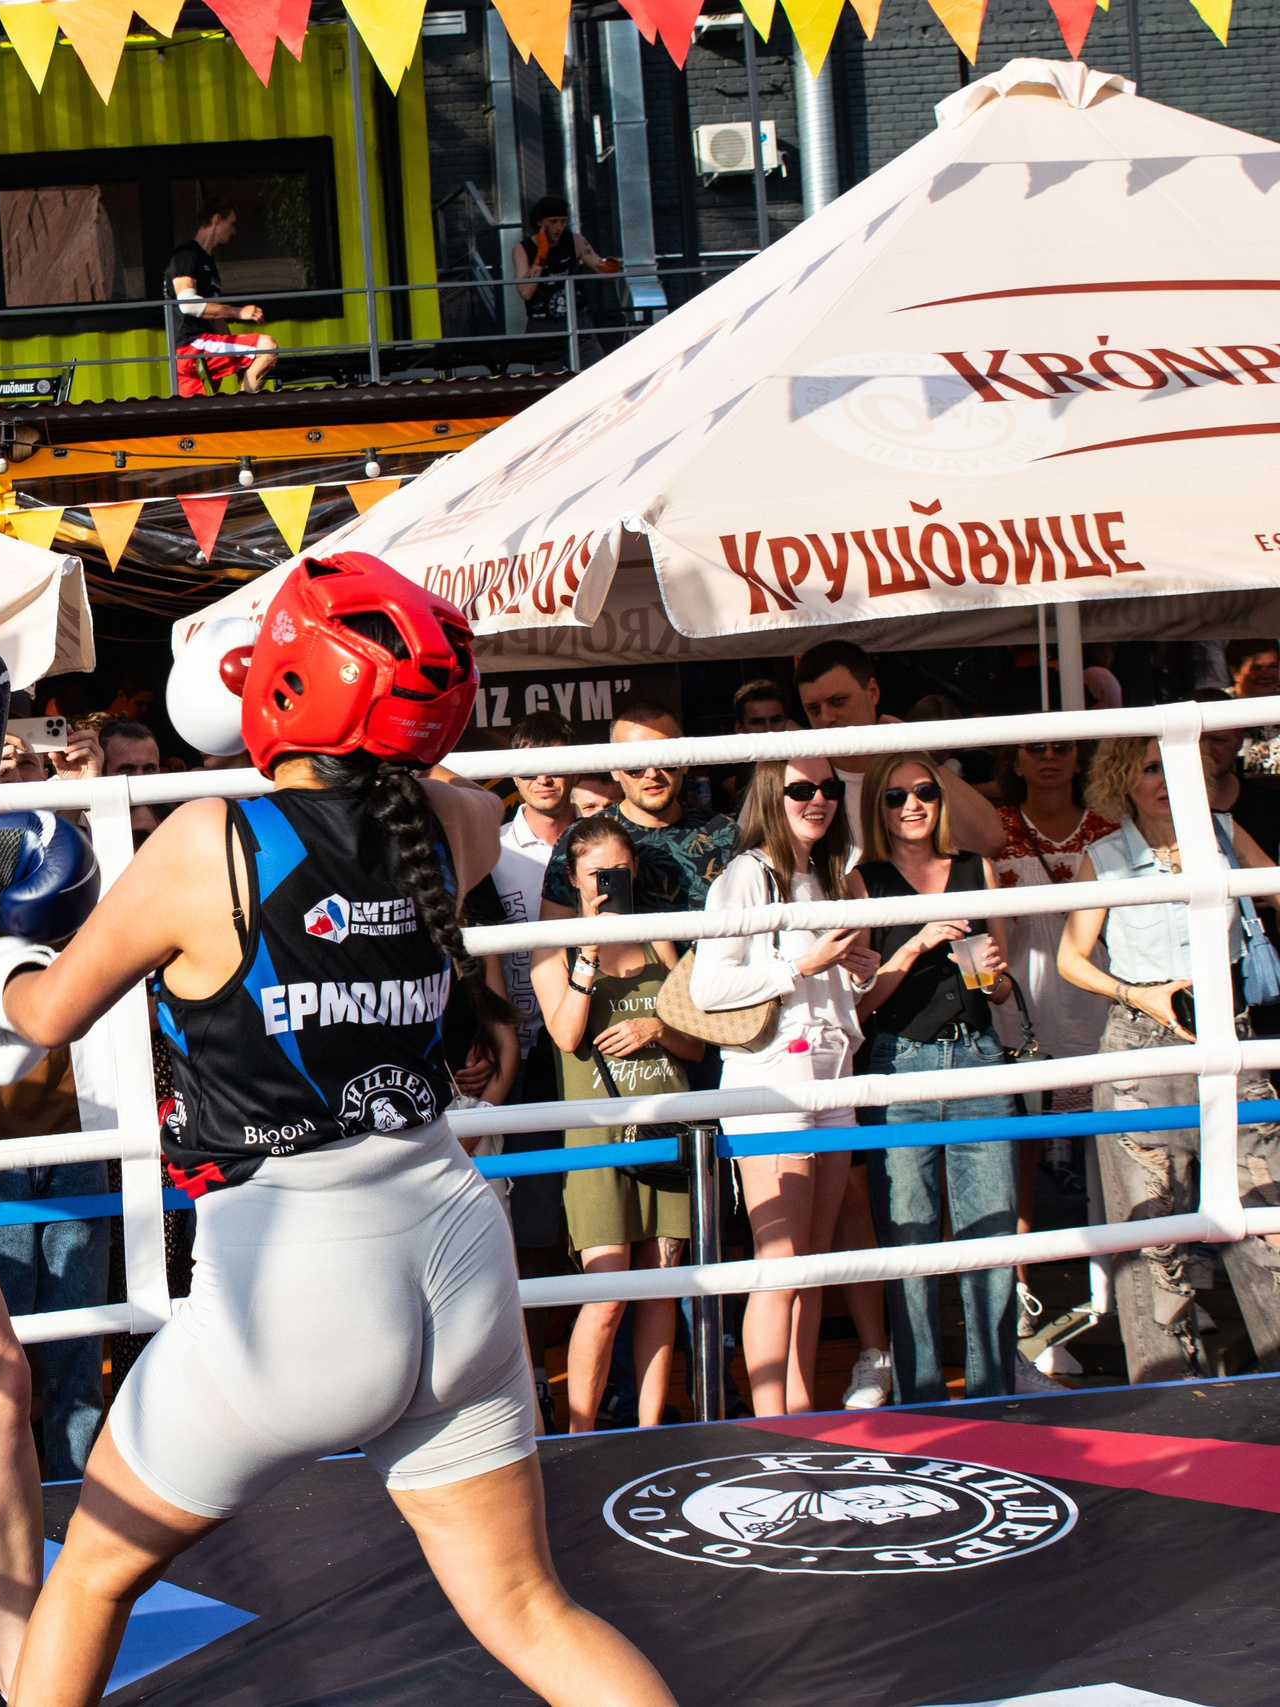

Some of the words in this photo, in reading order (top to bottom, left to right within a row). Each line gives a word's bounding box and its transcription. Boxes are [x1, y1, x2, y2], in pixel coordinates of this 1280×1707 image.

[932, 335, 1280, 403] KRÓNP
[350, 896, 417, 922] БИТВА
[260, 969, 451, 1036] ЕРМОЛИНА
[271, 1144, 294, 1155] GIN
[754, 1455, 1059, 1566] КАНЦЛЕРЪ
